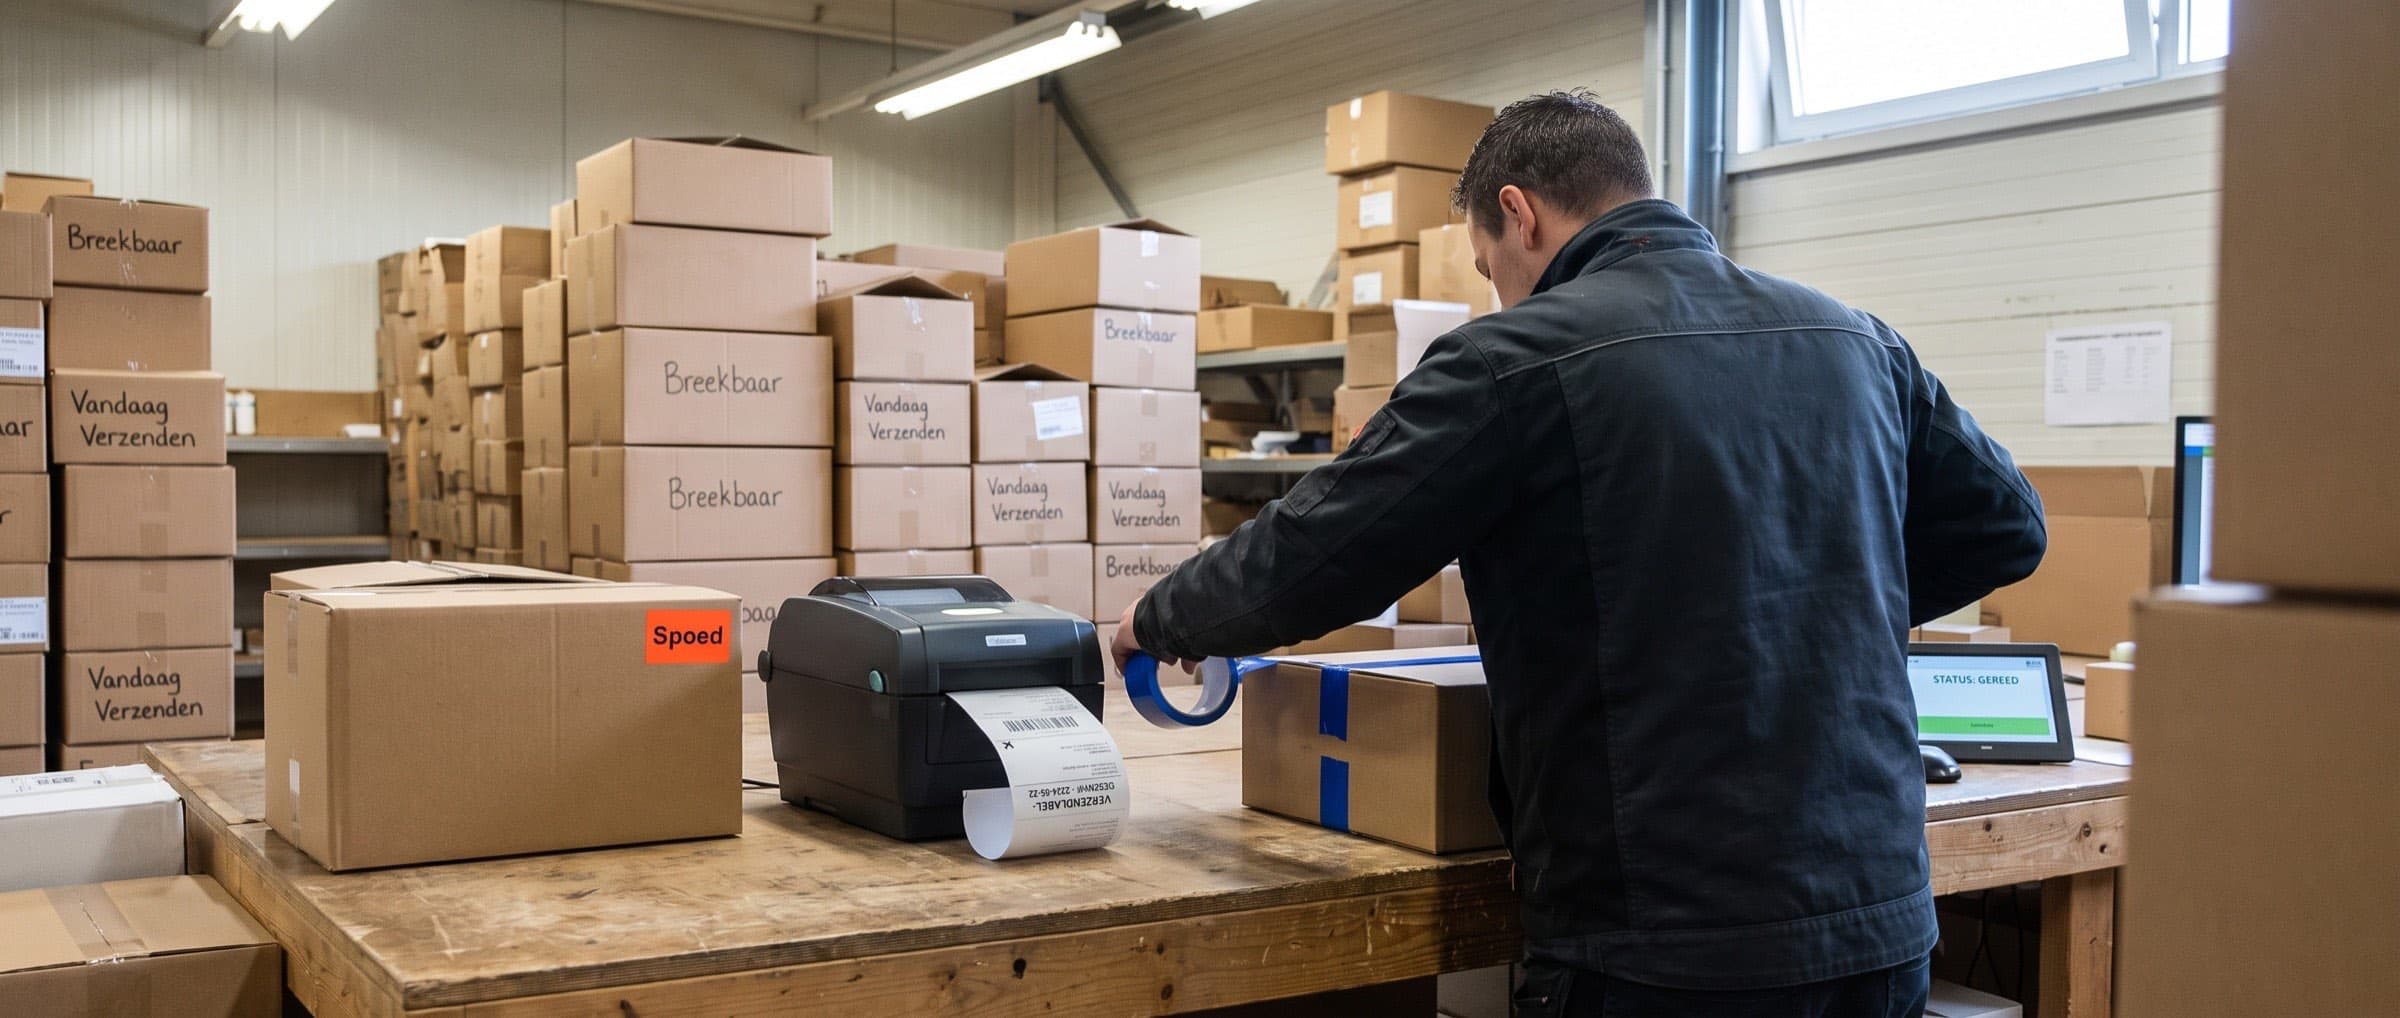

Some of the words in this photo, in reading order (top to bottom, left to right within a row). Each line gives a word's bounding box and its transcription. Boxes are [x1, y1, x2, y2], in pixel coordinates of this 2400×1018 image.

[67, 224, 183, 255] Breekbaar
[1105, 318, 1177, 343] Breekbaar
[664, 361, 783, 395] Breekbaar
[71, 388, 168, 425] Vandaag
[864, 393, 929, 421] Vandaag
[80, 424, 196, 448] Verzenden
[868, 421, 945, 441] Verzenden
[668, 476, 783, 511] Breekbaar
[986, 476, 1049, 501] Vandaag
[1109, 481, 1167, 508] Vandaag
[992, 502, 1064, 522] Verzenden
[1112, 508, 1180, 528] Verzenden
[653, 625, 723, 650] Spoed
[87, 666, 181, 695] Vandaag
[1933, 674, 1976, 685] STATUS:
[1978, 675, 2019, 685] GEREED
[95, 697, 204, 722] Verzenden
